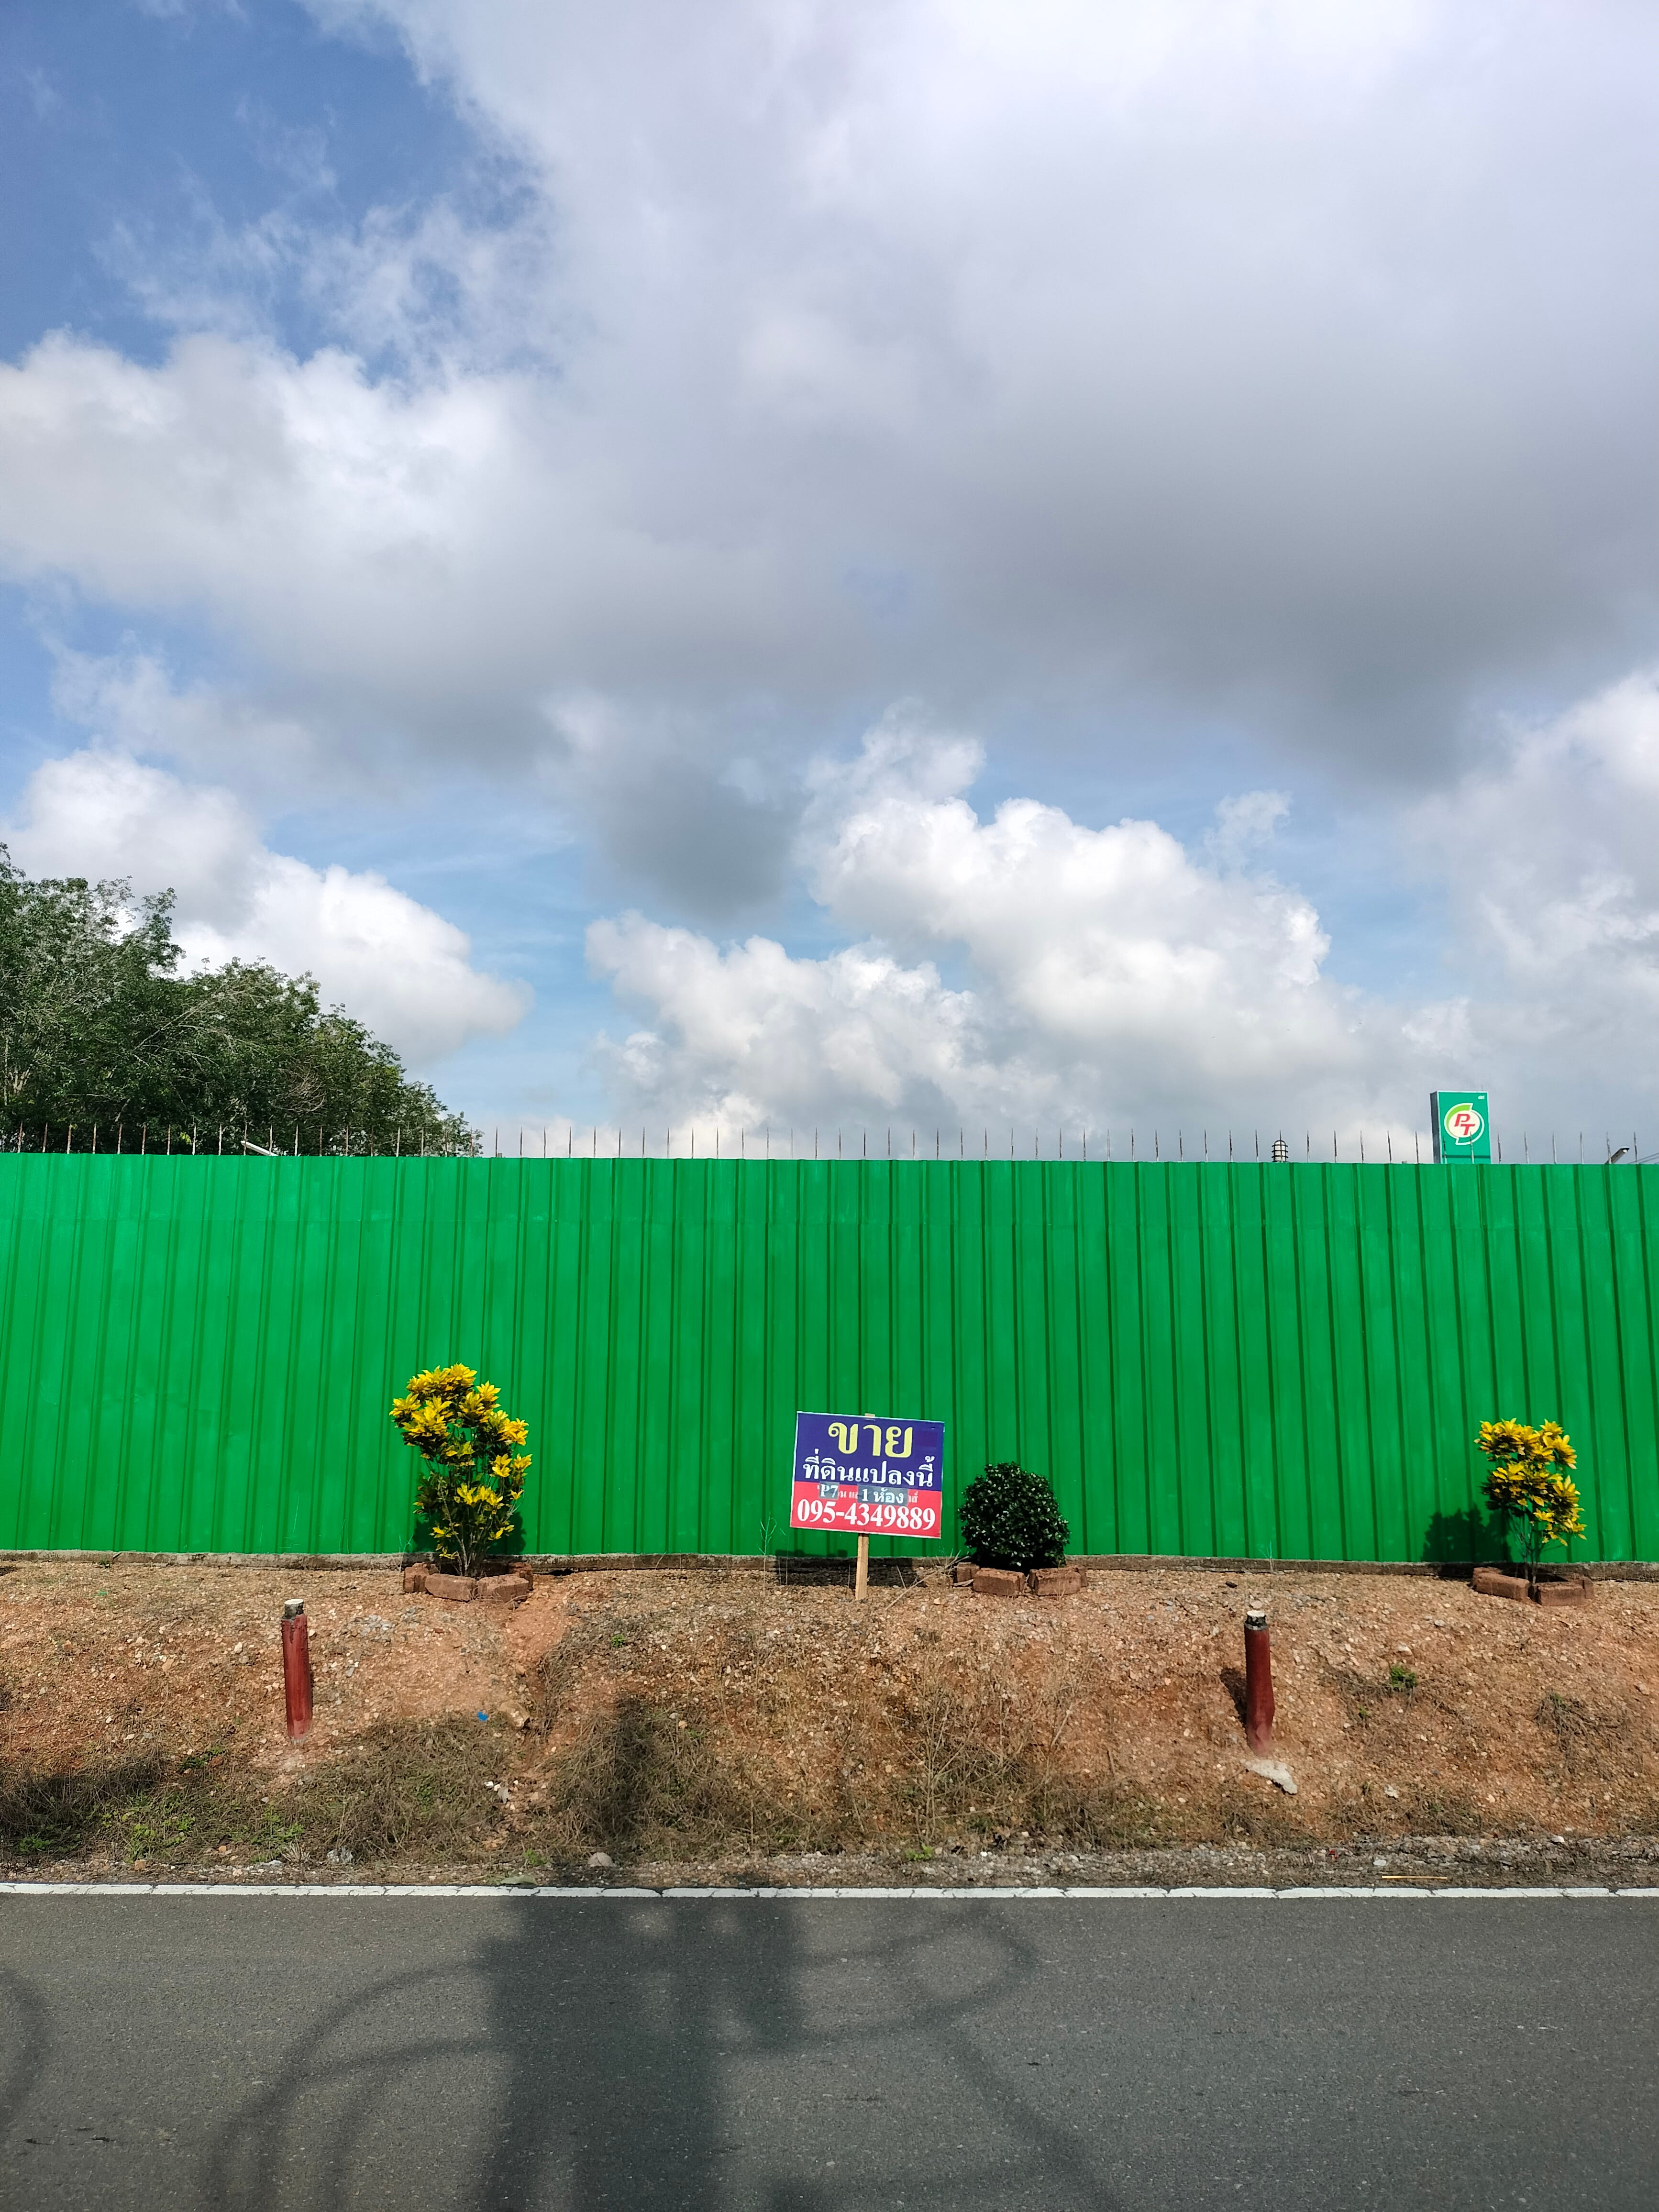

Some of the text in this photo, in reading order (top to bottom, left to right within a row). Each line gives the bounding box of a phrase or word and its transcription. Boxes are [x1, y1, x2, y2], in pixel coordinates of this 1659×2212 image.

[1454, 1113, 1476, 1136] PT
[828, 1422, 913, 1458] ขาย
[803, 1449, 935, 1487] ที่ดินแปลงนี้
[820, 1484, 839, 1498] P7
[862, 1488, 868, 1501] 1
[873, 1487, 904, 1504] ห้อง
[797, 1499, 936, 1530] 095-4349889
